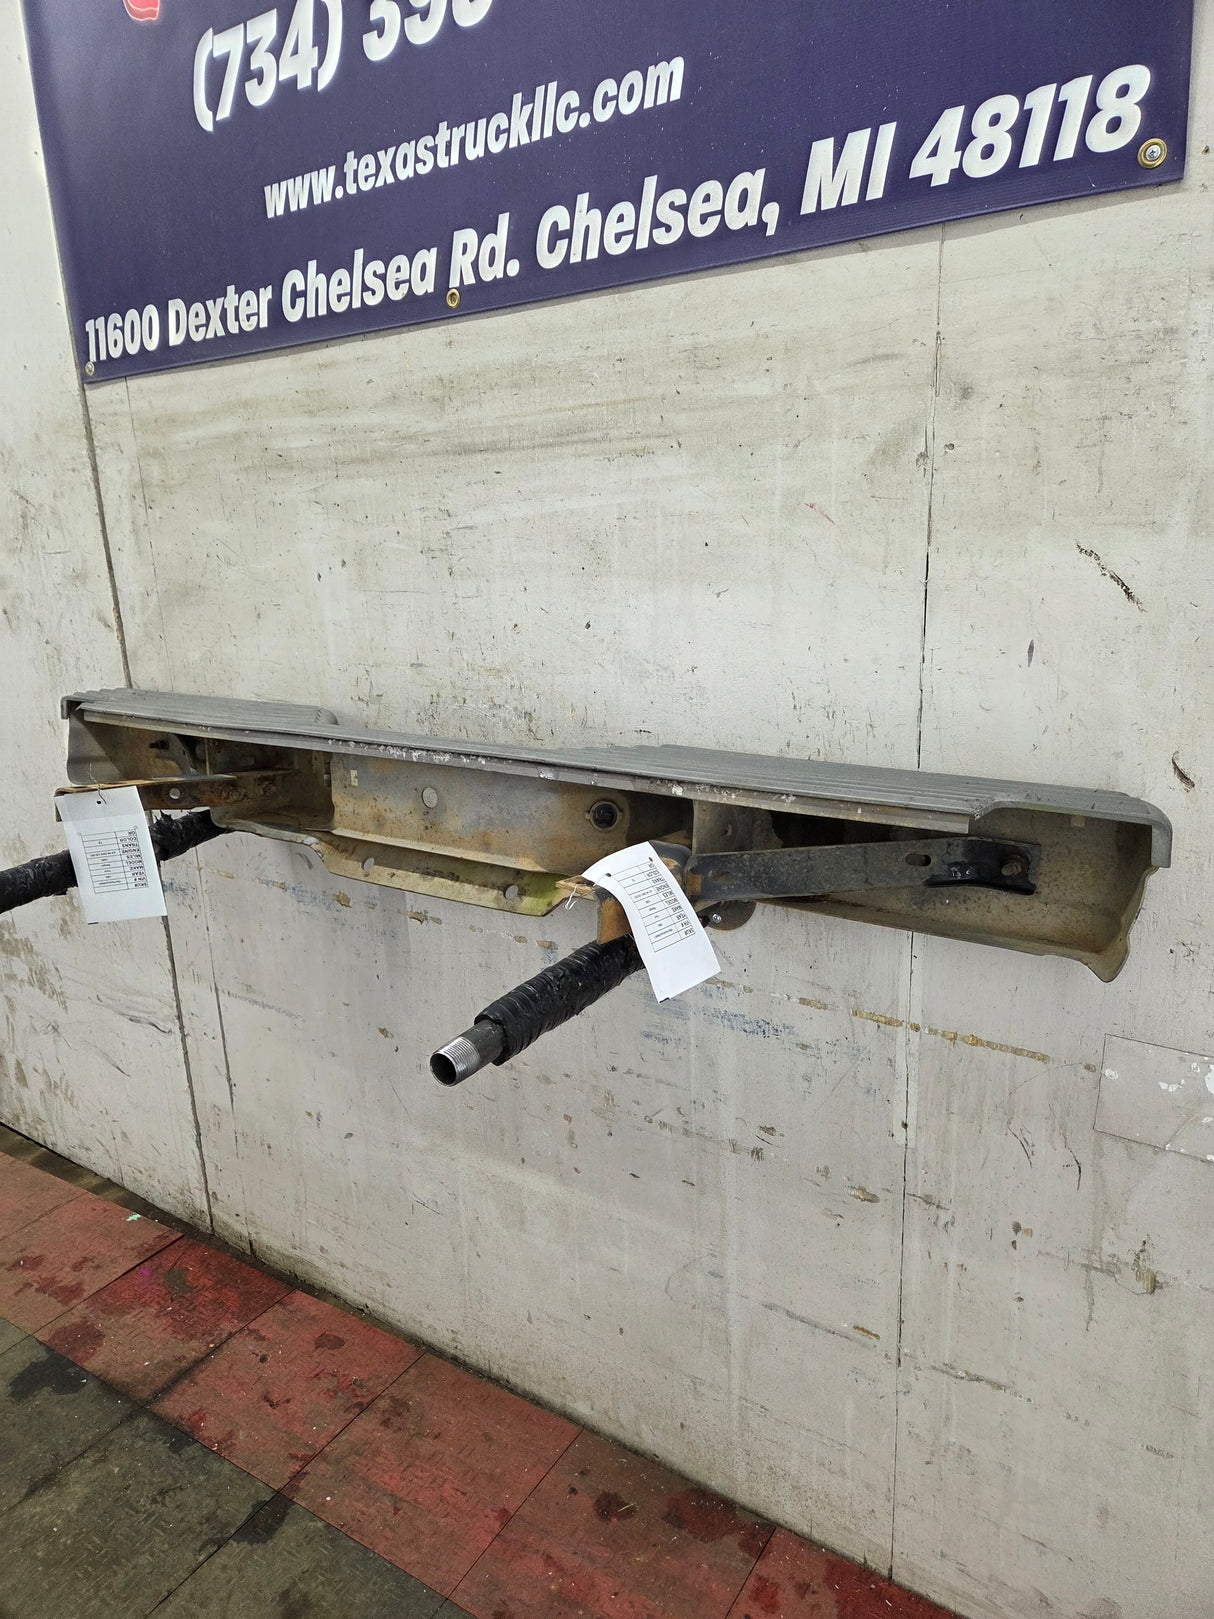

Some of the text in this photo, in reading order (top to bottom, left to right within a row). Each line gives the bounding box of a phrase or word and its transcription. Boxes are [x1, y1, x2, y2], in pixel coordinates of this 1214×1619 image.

[193, 0, 343, 132] (734)
[264, 57, 685, 219] www.texastruckllc.com
[85, 64, 1151, 362] 11600 Dexter Chelsea Rd. Chelsea, MI 48118
